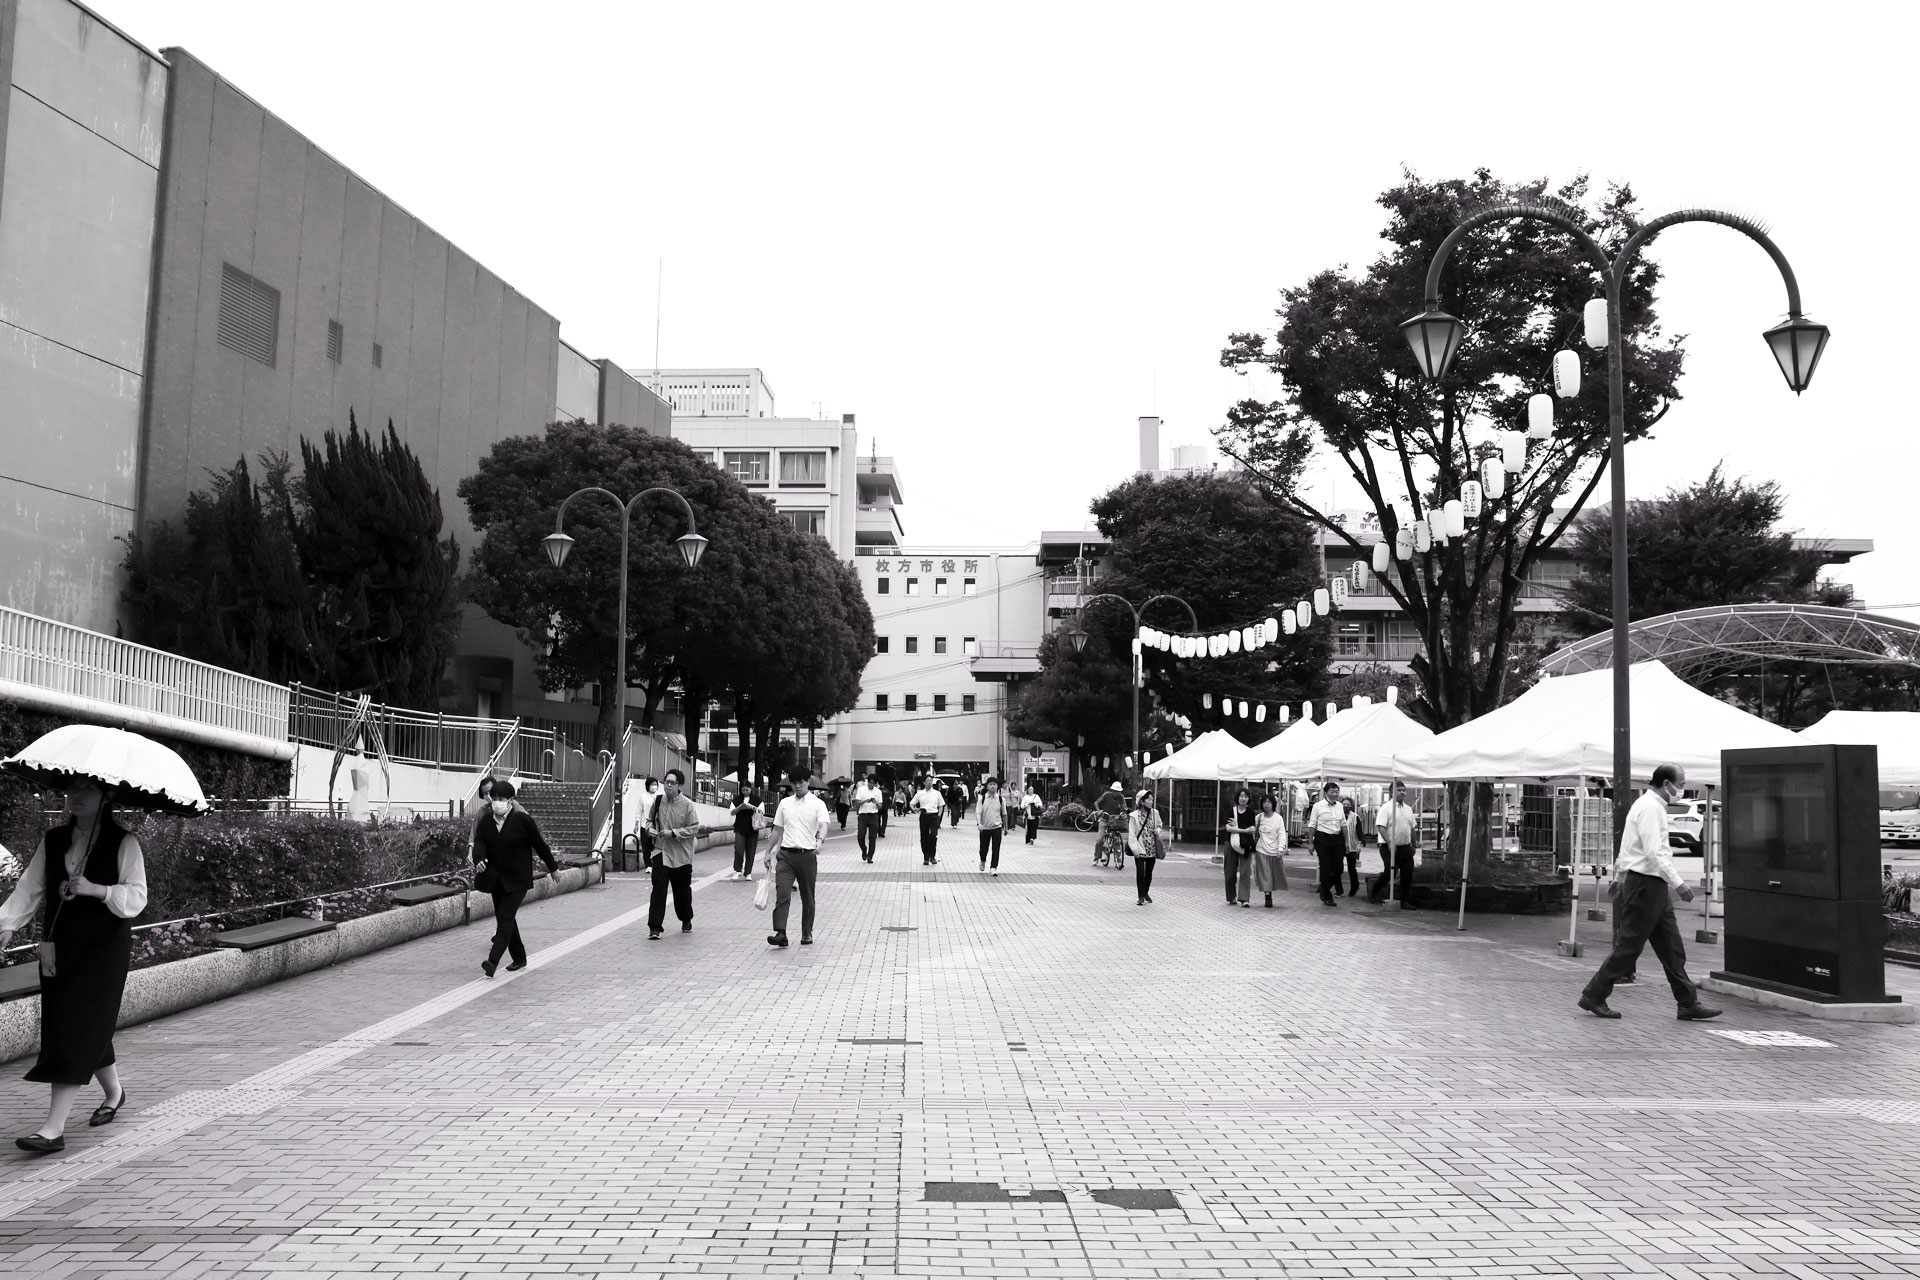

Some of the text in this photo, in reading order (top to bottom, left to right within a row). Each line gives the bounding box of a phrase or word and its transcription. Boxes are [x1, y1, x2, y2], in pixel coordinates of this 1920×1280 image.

[875, 559, 978, 573] 枚方市役所
